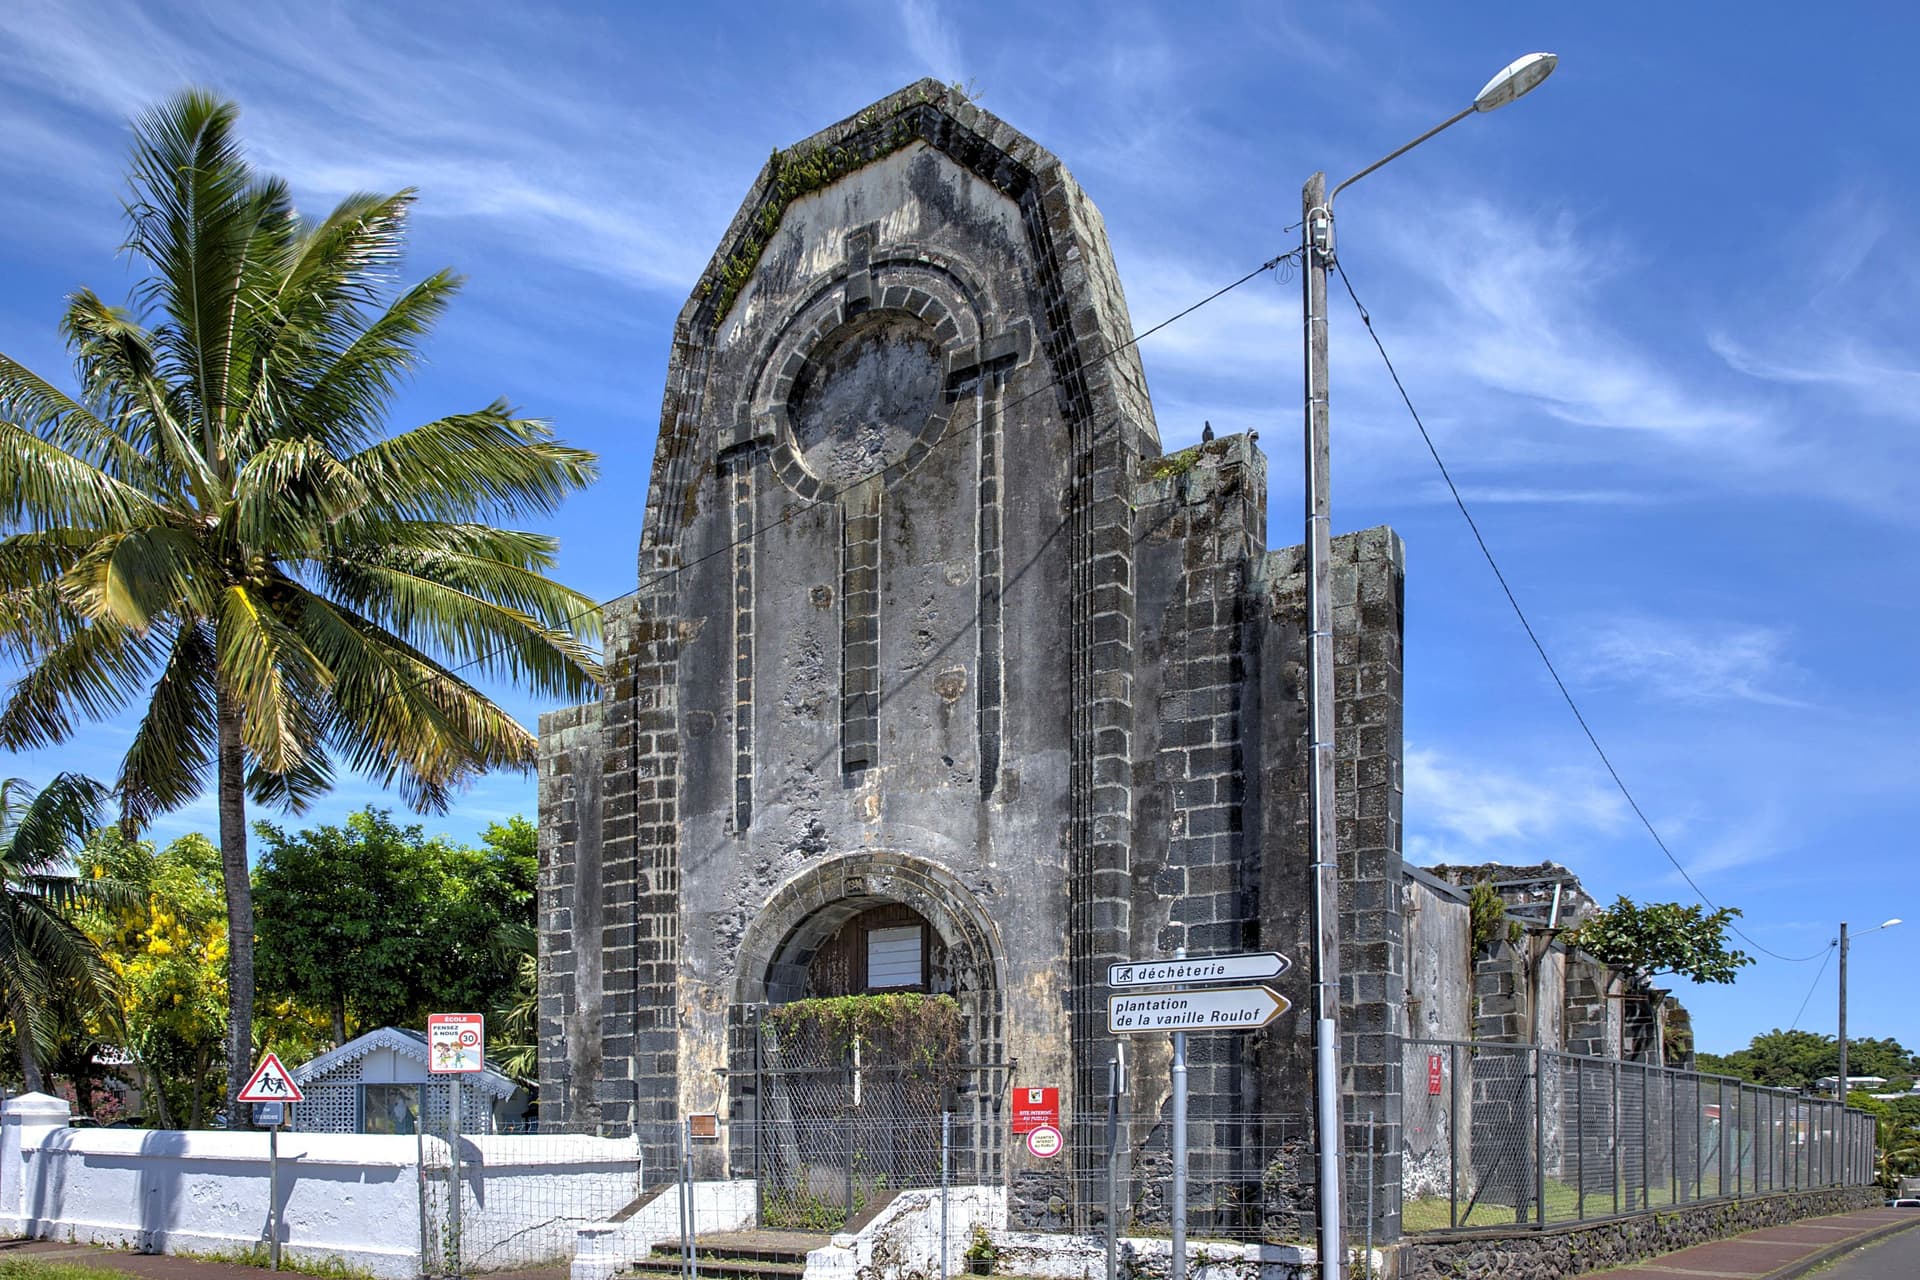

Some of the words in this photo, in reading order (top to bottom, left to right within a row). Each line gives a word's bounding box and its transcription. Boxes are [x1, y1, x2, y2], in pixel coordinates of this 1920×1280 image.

[1138, 963, 1225, 980] déchèterie
[1116, 998, 1188, 1015] plantation
[1116, 1015, 1133, 1027] de
[1138, 1014, 1150, 1026] la
[1157, 1012, 1205, 1025] vanille
[1210, 1008, 1261, 1022] Roulof
